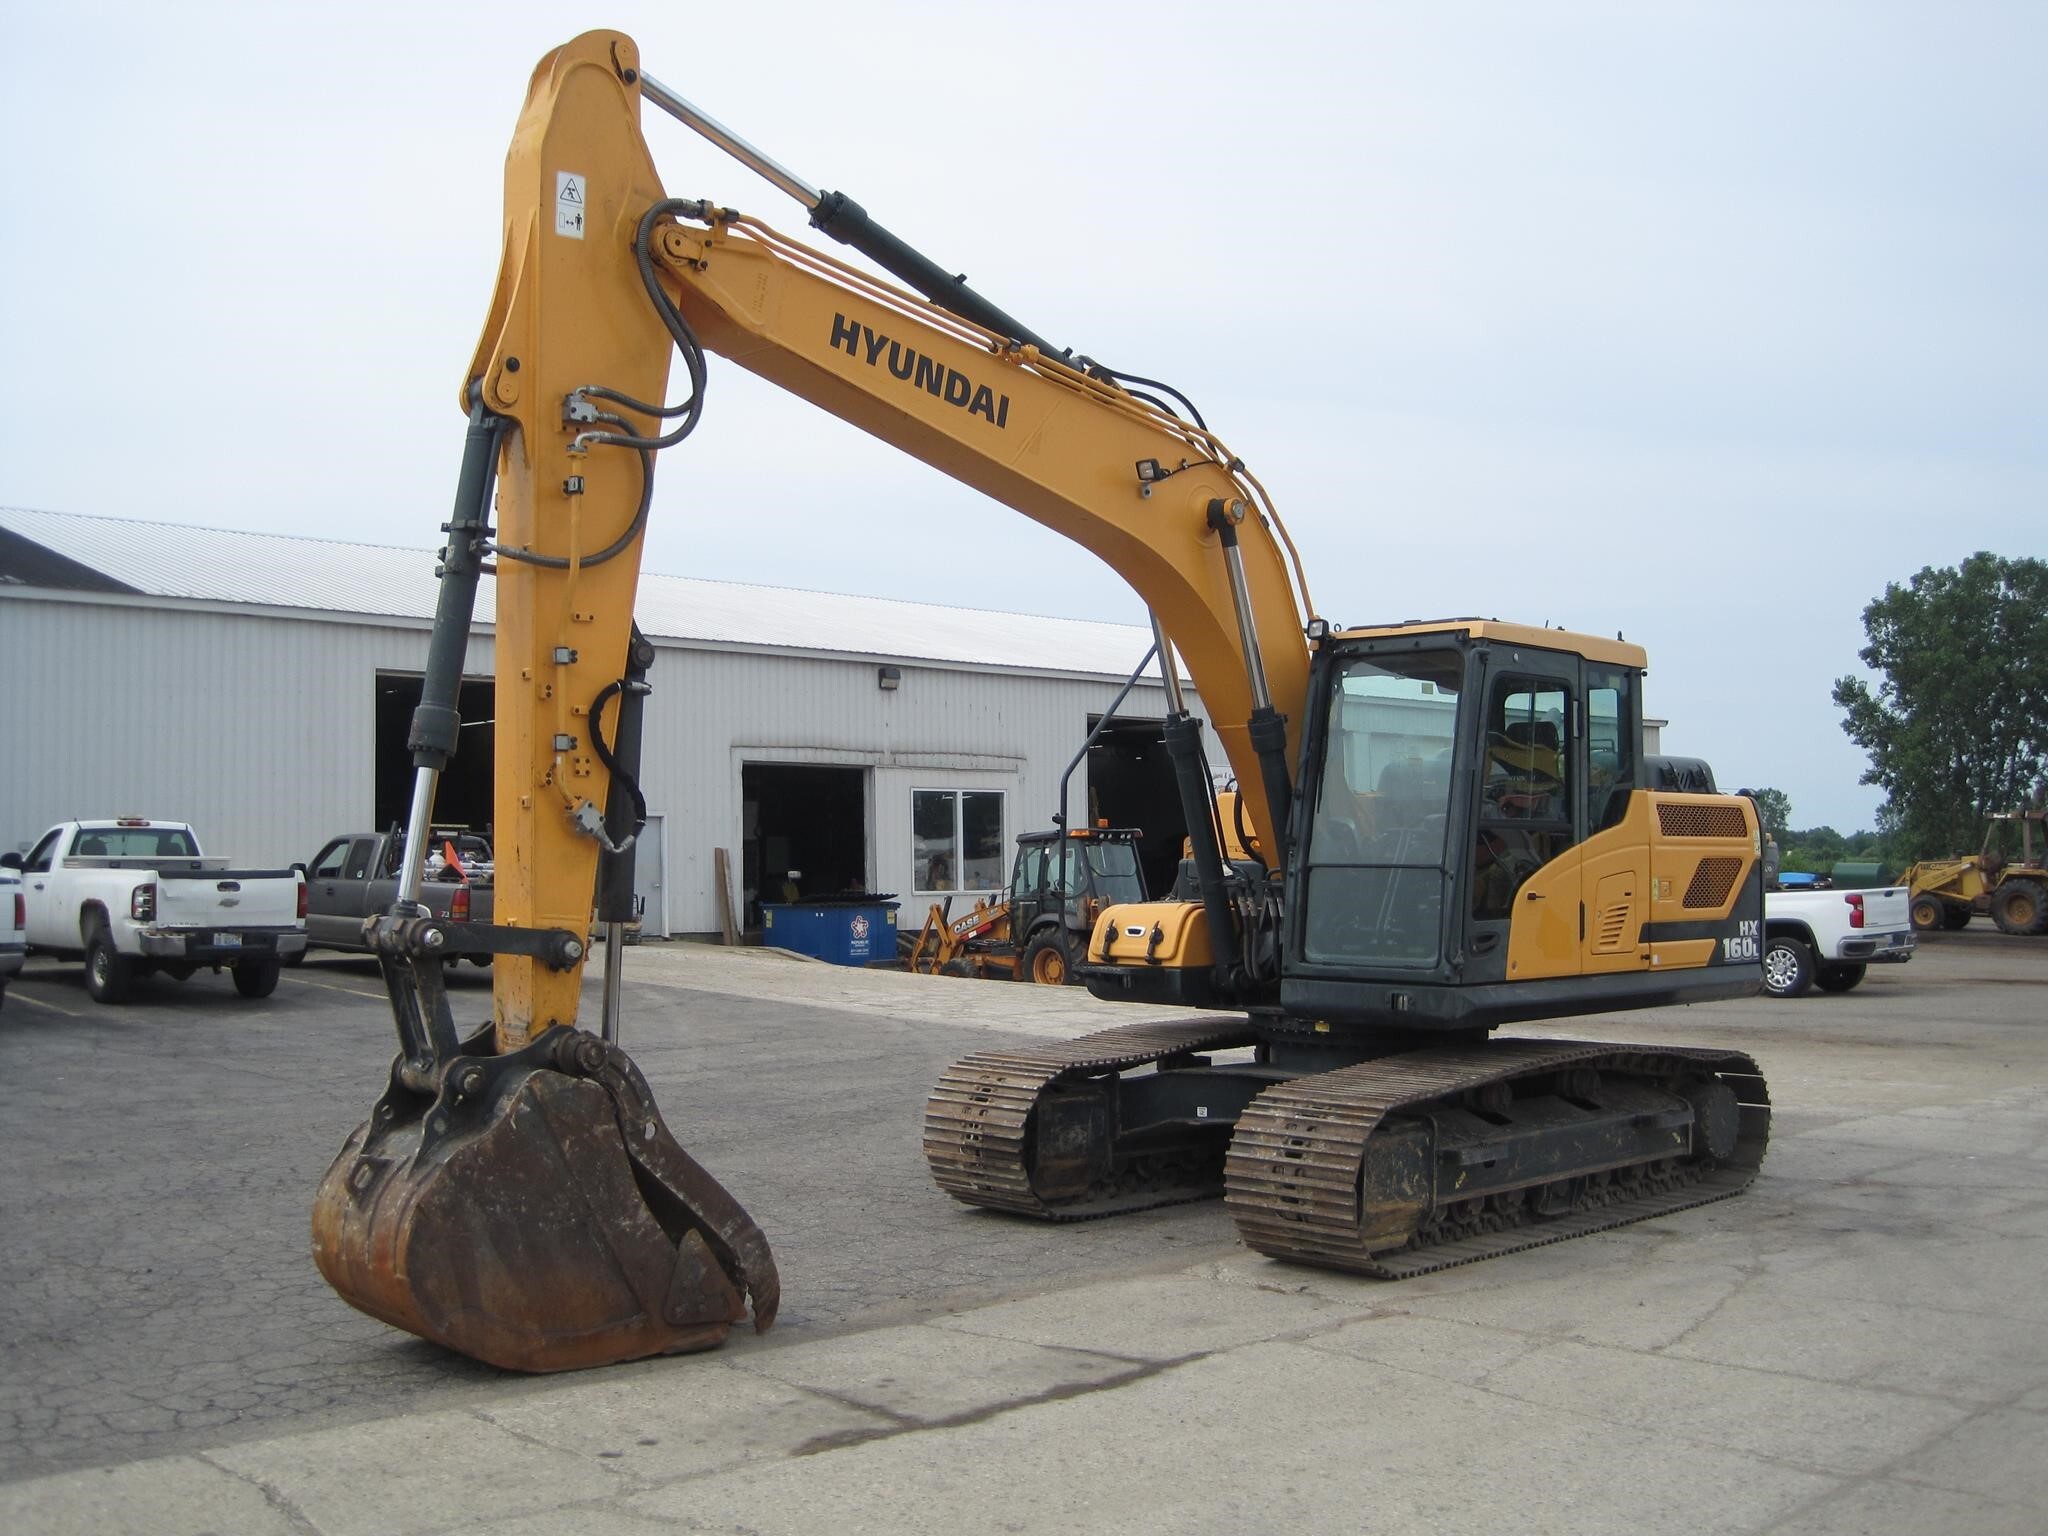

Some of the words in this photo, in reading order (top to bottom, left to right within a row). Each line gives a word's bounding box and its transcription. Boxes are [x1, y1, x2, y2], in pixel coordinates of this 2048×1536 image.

[830, 313, 1009, 428] HYUNDAI
[954, 915, 980, 934] CASE
[1739, 920, 1758, 936] HX
[1723, 937, 1759, 960] 160L
